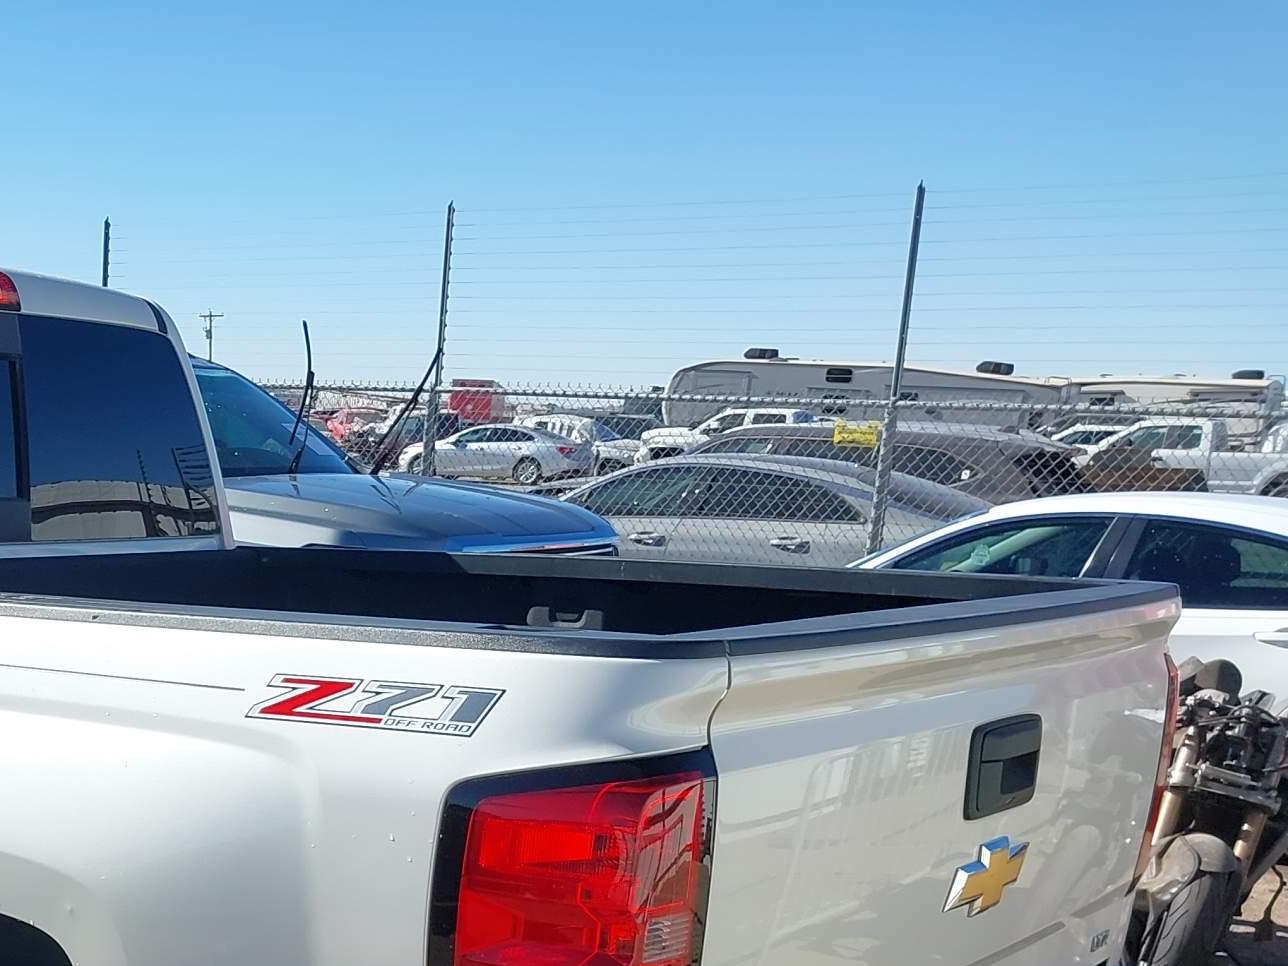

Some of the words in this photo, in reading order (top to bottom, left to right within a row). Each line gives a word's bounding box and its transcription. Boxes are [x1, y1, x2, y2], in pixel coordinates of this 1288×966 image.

[244, 673, 506, 735] Z71
[384, 718, 419, 727] OFF
[421, 721, 472, 734] ROAD
